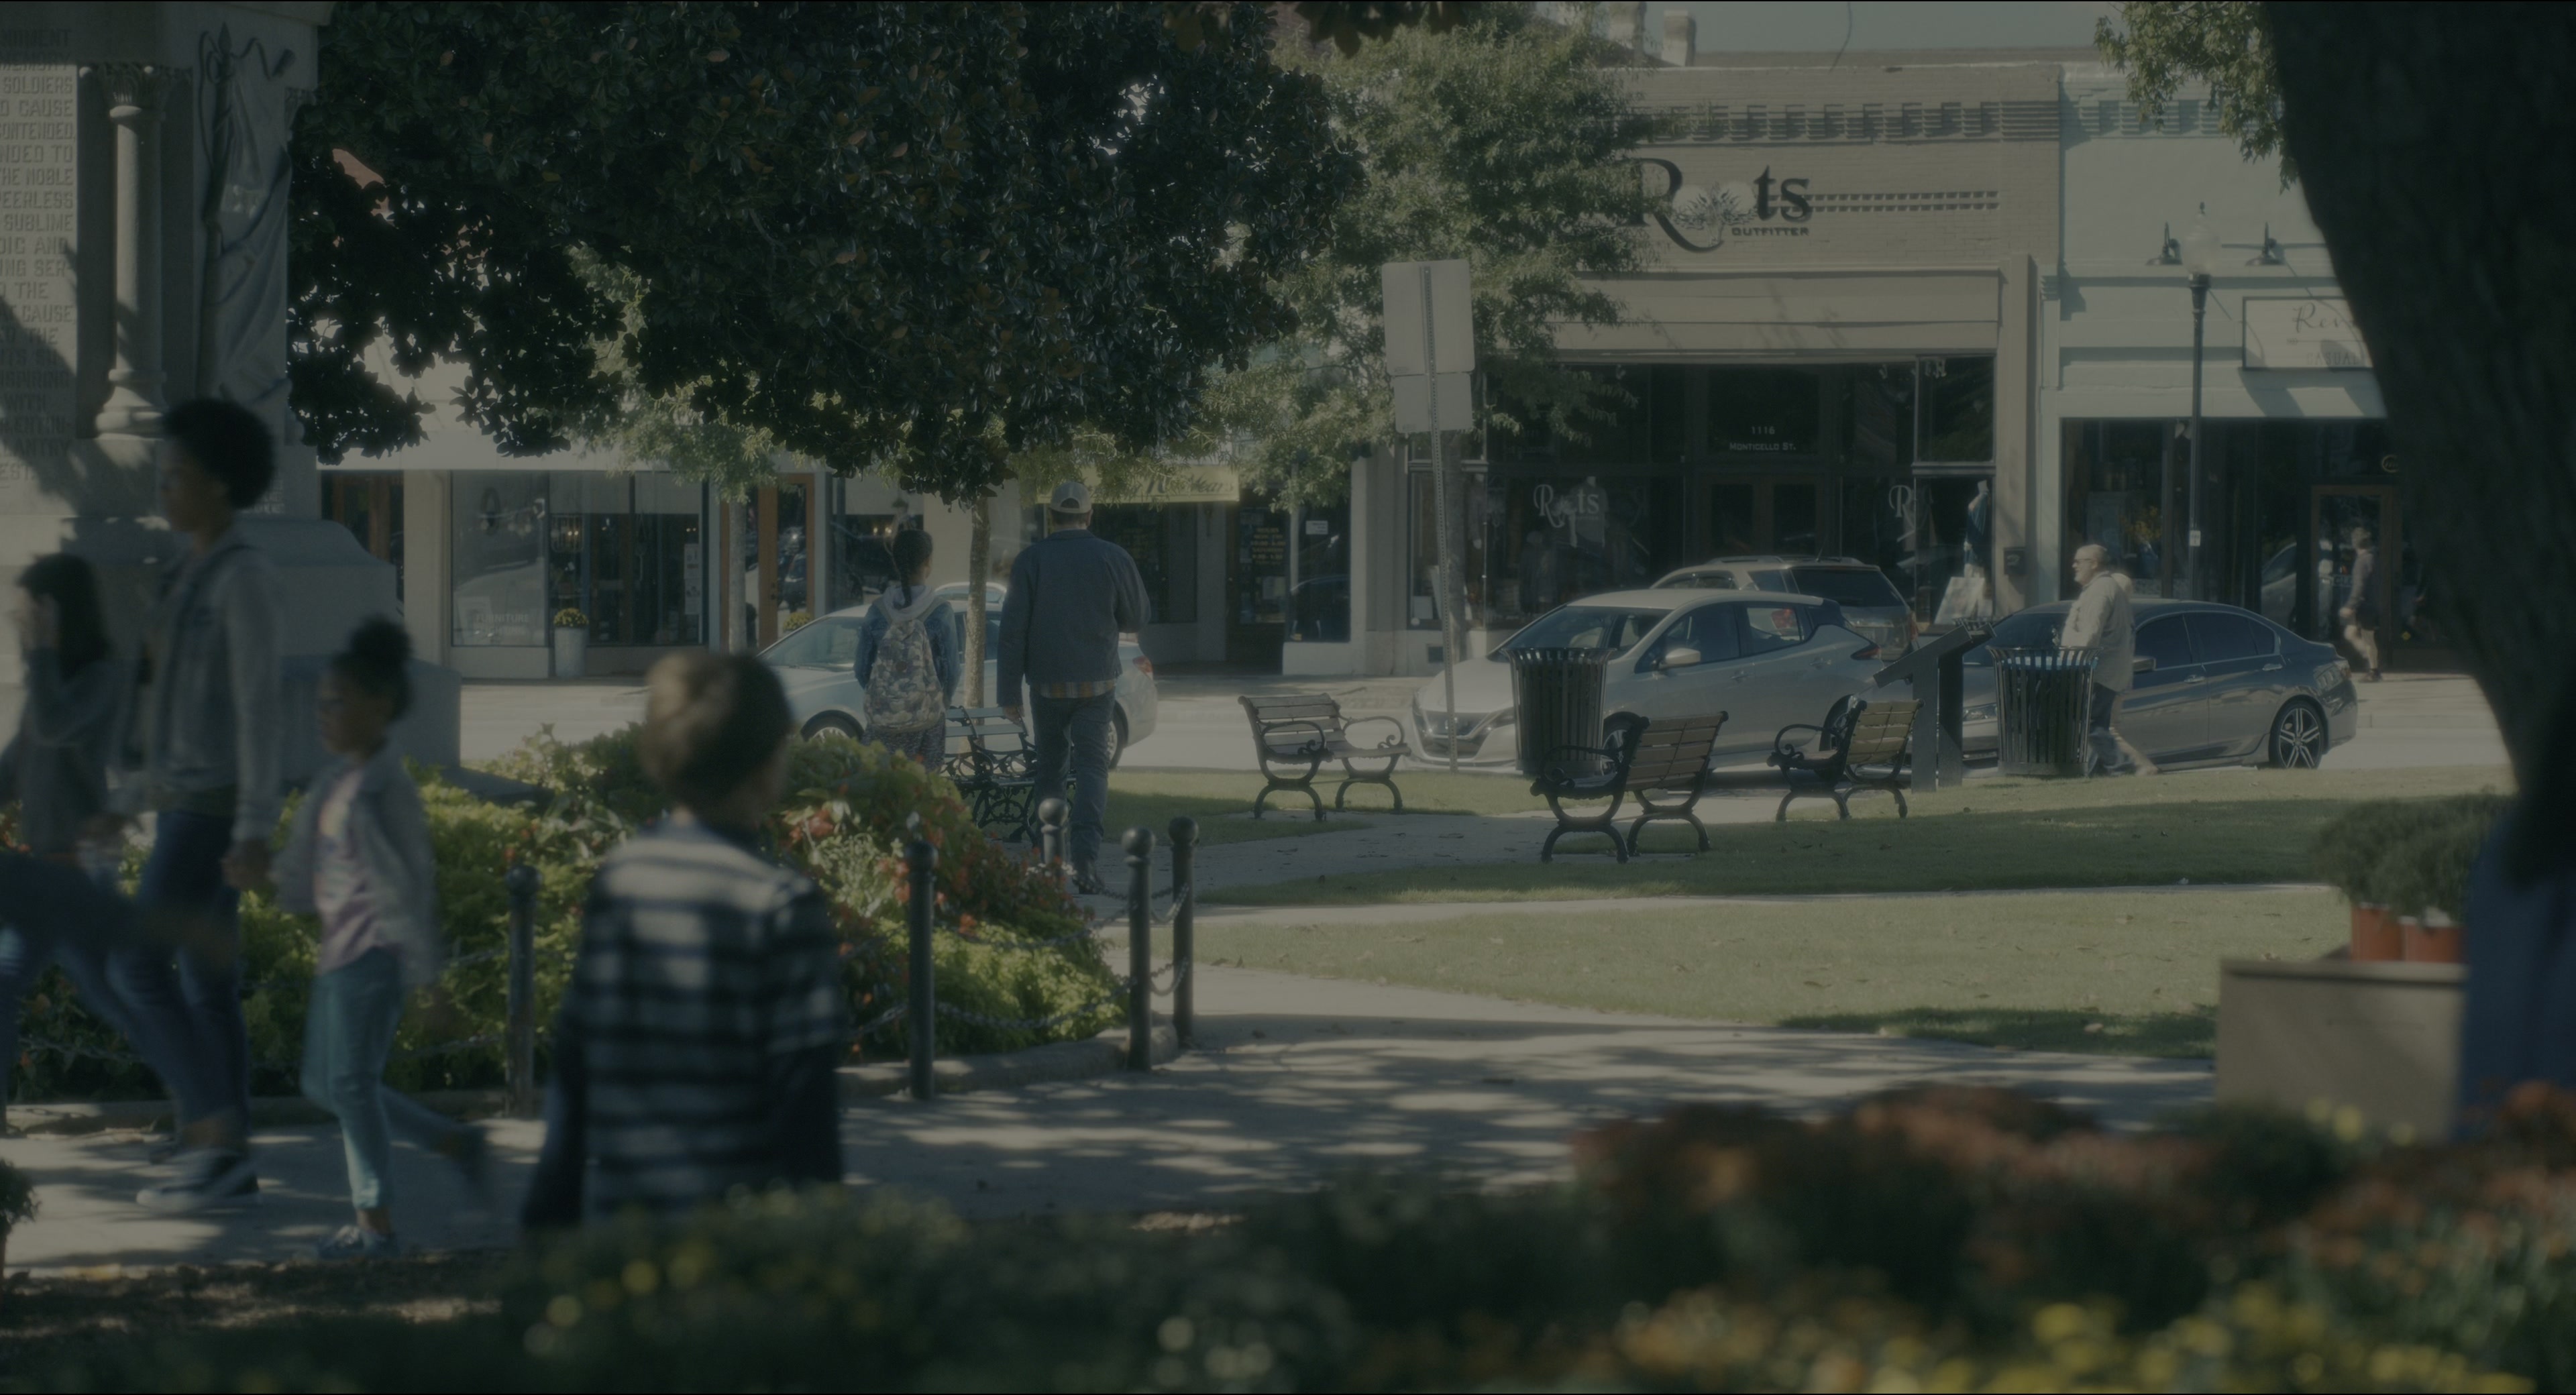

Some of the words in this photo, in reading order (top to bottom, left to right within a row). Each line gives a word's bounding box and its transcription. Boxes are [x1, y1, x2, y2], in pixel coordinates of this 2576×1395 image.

[3, 76, 72, 94] SOLDIERS
[19, 99, 73, 117] CAUSE
[50, 144, 72, 163] TO
[26, 168, 73, 185] NOBLE
[0, 190, 73, 209] EERLESS
[5, 213, 73, 231] SUBLIME
[1731, 227, 1810, 237] OUTFITTER
[34, 236, 68, 254] AND
[14, 281, 48, 299] THE
[25, 327, 58, 344] THE
[1751, 426, 1775, 435] 1116
[1729, 442, 1780, 451] MONTICELLO
